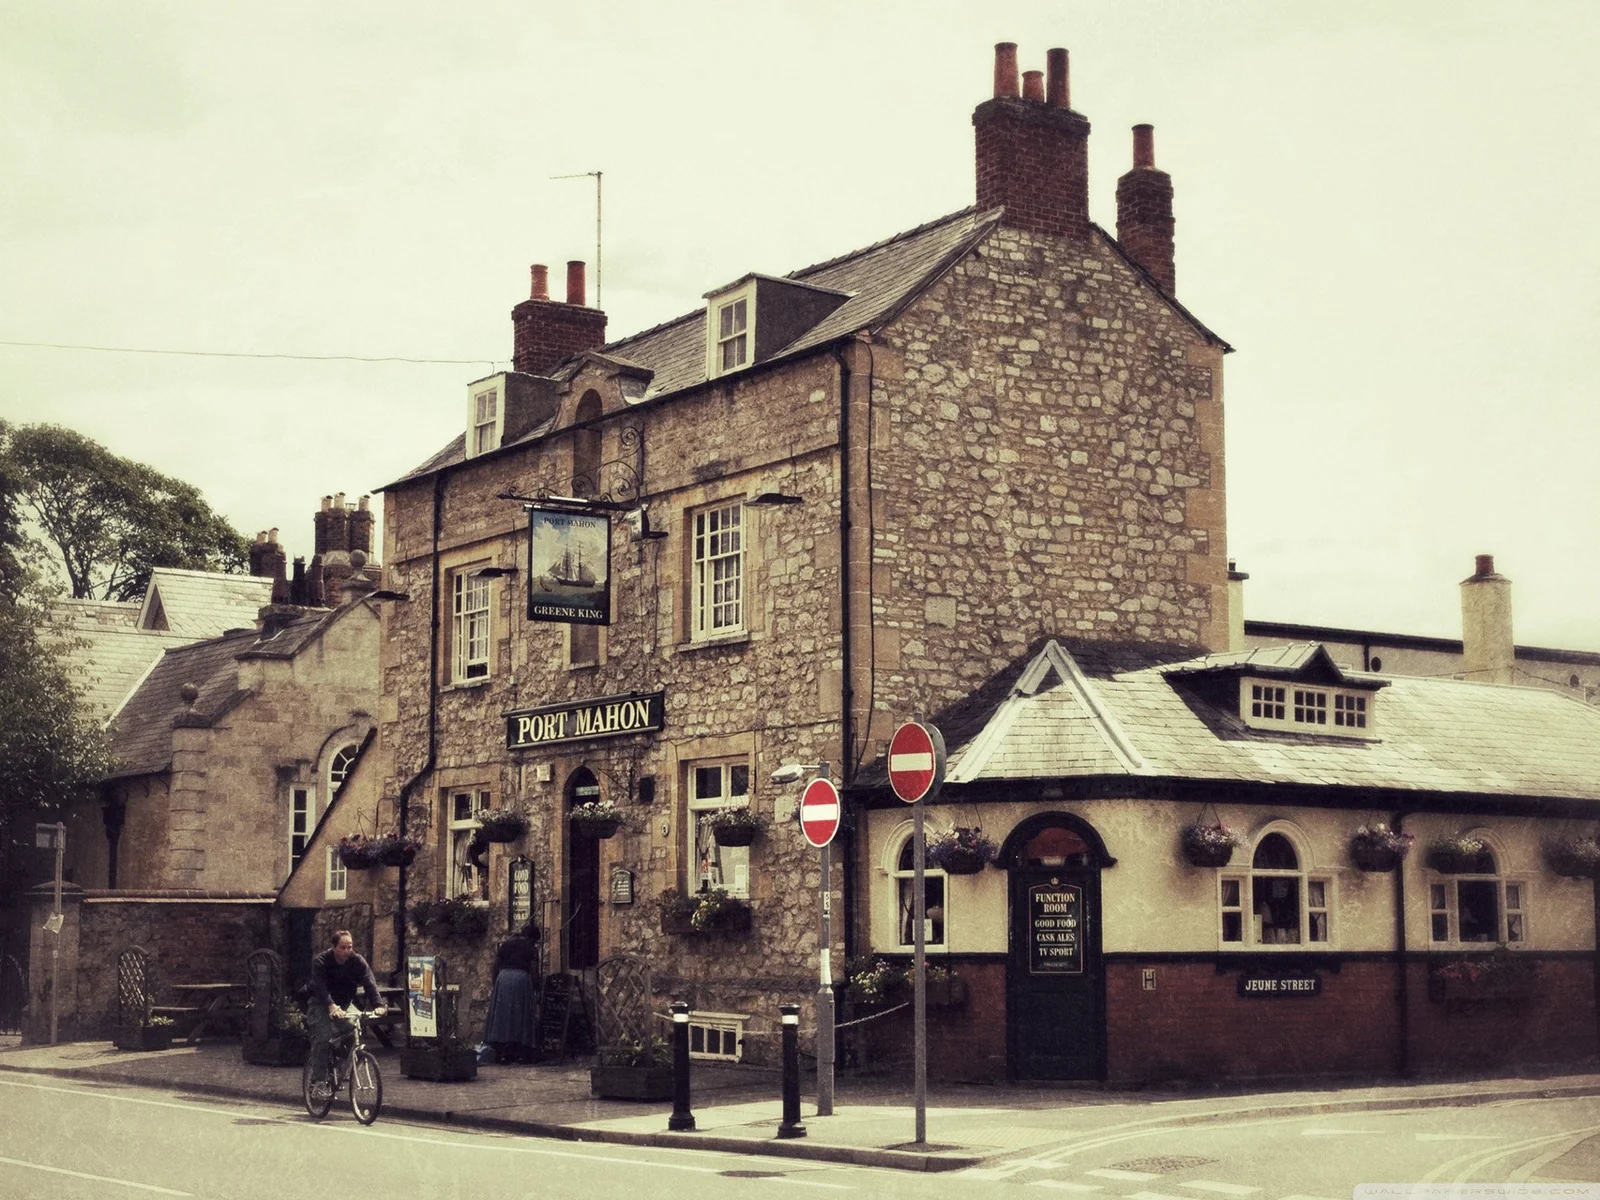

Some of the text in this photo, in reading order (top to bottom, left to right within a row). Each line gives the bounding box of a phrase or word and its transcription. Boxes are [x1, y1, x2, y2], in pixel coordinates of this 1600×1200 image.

[543, 516, 596, 528] PORT MAHON
[534, 605, 603, 619] GREENE KING
[517, 699, 651, 744] PORT MAHON
[1035, 893, 1075, 903] FUNCTION
[1043, 903, 1067, 913] ROOM
[1034, 919, 1077, 928] GOOD FOOD
[1036, 933, 1075, 942] CASK ALES
[1039, 947, 1074, 956] TV SPORT
[1245, 979, 1316, 991] JEUNE STREET
